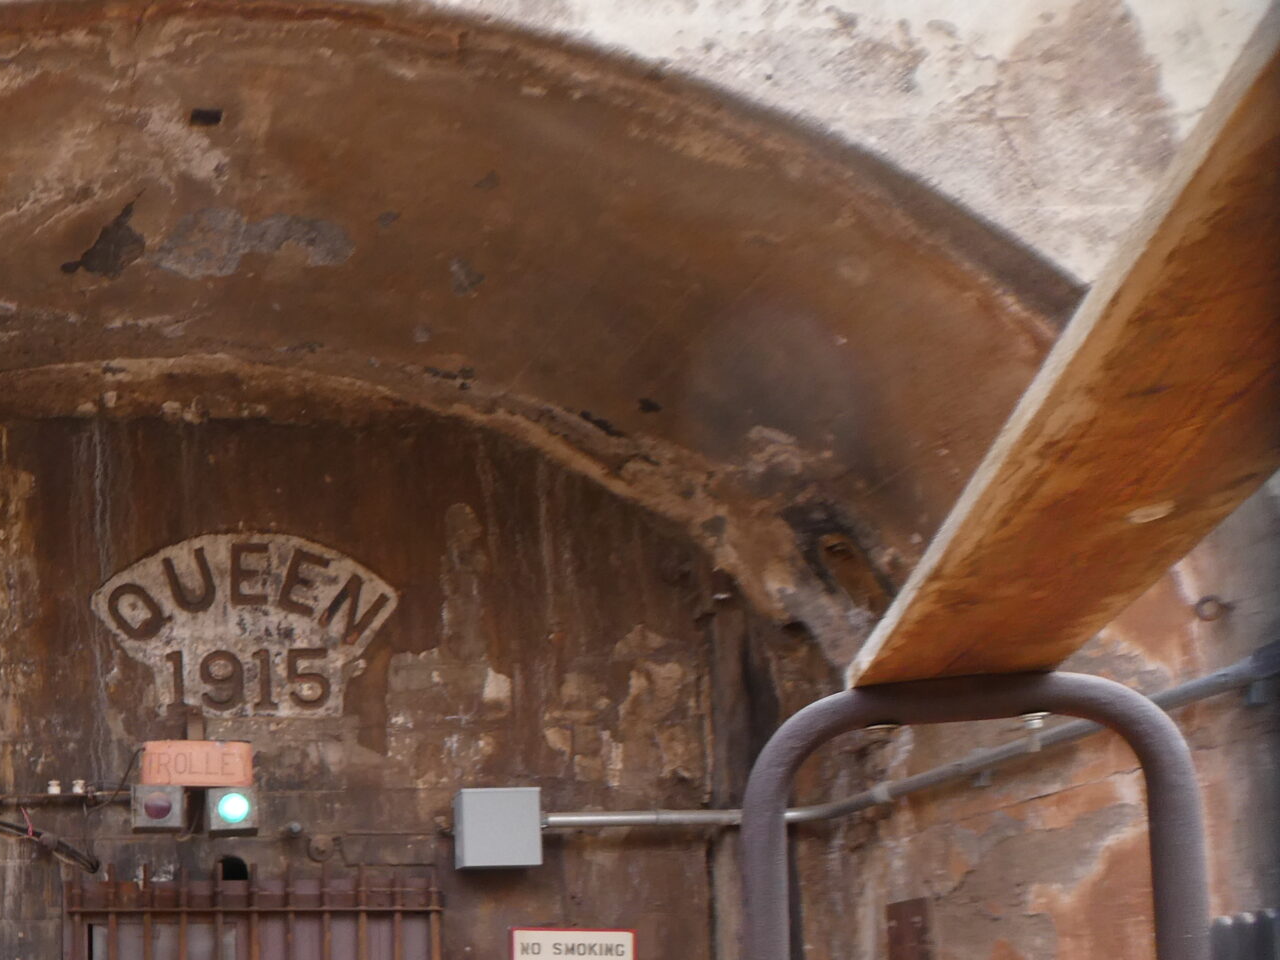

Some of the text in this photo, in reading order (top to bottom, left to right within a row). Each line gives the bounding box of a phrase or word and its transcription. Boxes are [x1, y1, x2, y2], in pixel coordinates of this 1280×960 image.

[107, 542, 391, 646] QUEEN
[166, 647, 332, 712] 1915
[520, 941, 626, 957] NO SMOKING
